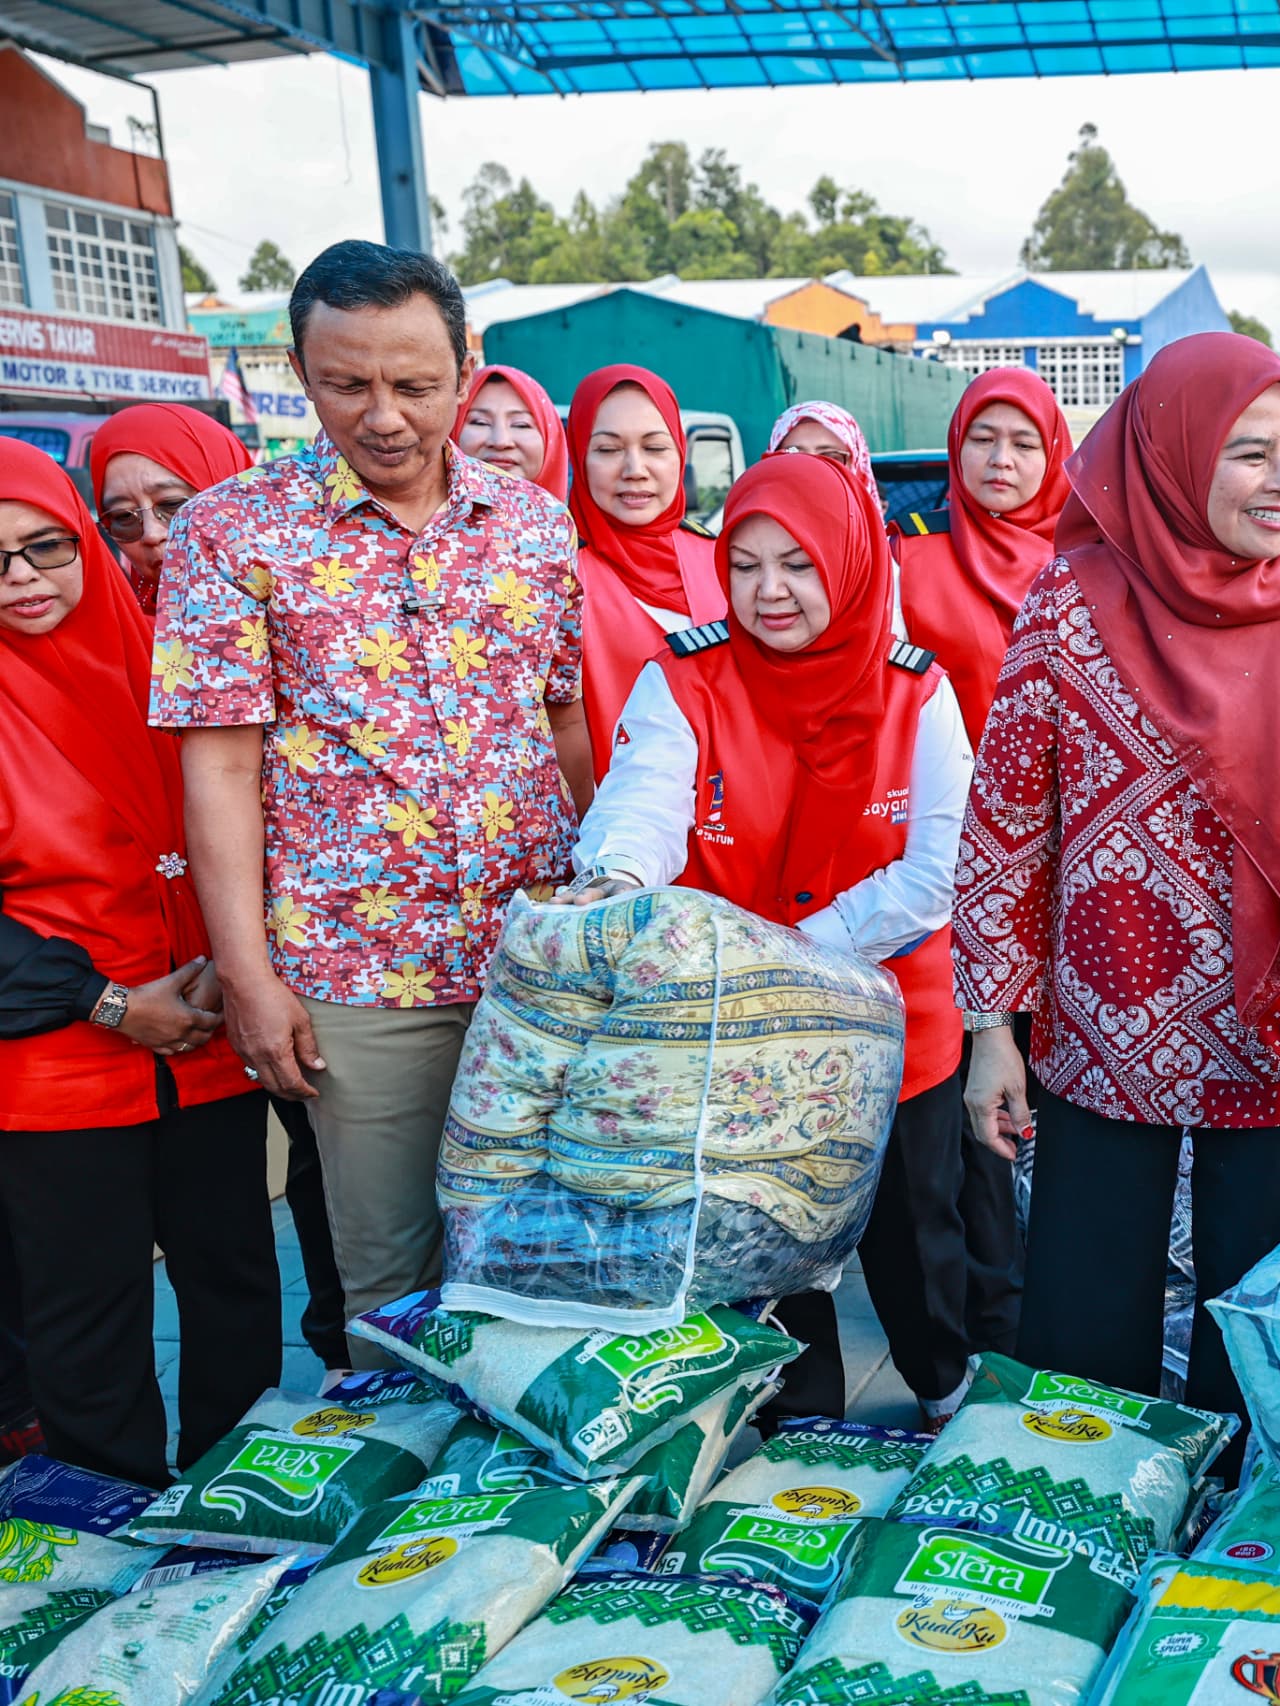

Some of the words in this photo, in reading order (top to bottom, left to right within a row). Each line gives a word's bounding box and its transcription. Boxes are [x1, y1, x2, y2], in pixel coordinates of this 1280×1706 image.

[46, 322, 97, 357] TAYAR
[2, 361, 68, 386] MOTOR
[93, 369, 135, 392] TYRE
[138, 374, 203, 398] SERVICE
[902, 1493, 1003, 1524] Beras
[899, 1611, 997, 1645] KualiKu
